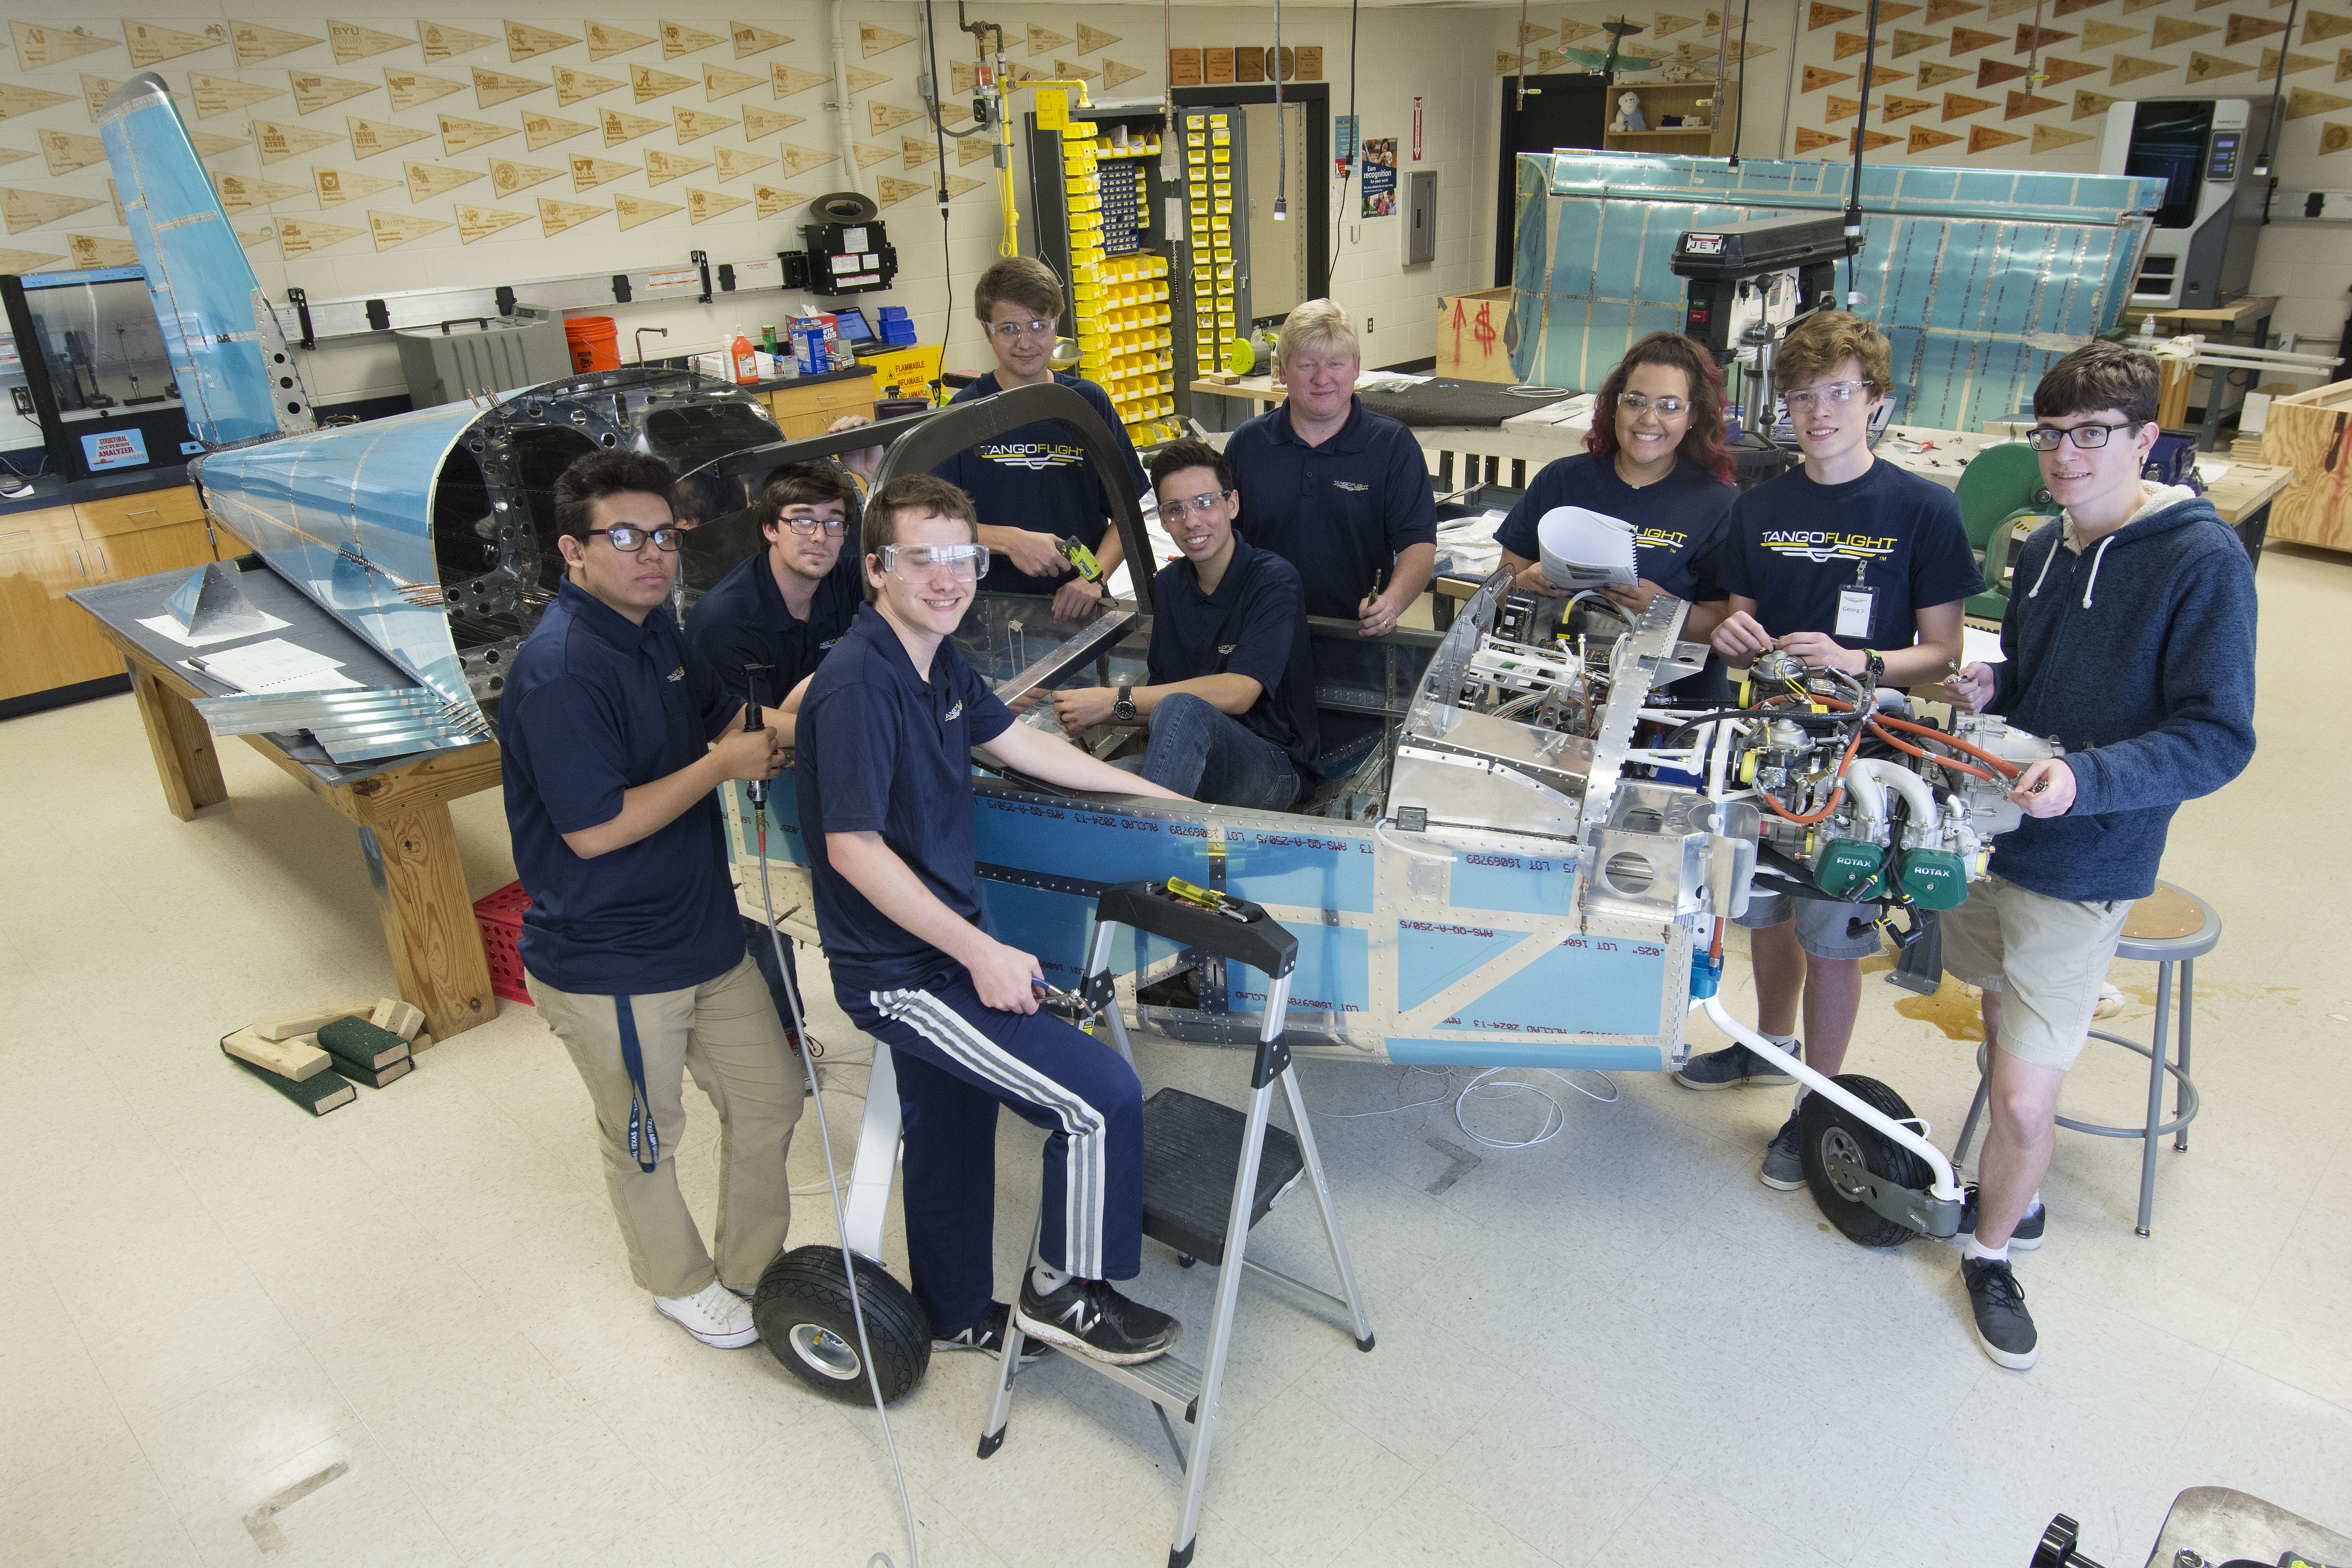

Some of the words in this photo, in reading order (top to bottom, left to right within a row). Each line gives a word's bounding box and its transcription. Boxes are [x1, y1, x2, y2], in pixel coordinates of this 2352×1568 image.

[333, 27, 359, 35] BYU
[1364, 169, 1391, 179] recognition
[1690, 241, 1719, 250] JET
[895, 361, 925, 372] FLAMMABLE
[897, 375, 924, 387] INFLAMABLE
[99, 441, 130, 450] STRESS
[100, 435, 127, 445] STRUCTURAL
[99, 446, 134, 458] ANALYZER
[1762, 530, 1898, 550] TANGOFLIGHT
[1073, 813, 1115, 828] 2024-T3
[1122, 819, 1158, 833] ALCLAD
[1224, 830, 1245, 842] LOT
[1529, 860, 1550, 871] LOT
[1837, 857, 1871, 867] ROTAX
[1915, 866, 1951, 877] ROTAX
[1400, 920, 1493, 937] AMS-QQ-A-250/5
[1597, 941, 1618, 951] LOT
[1473, 1020, 1519, 1031] 2024-T3
